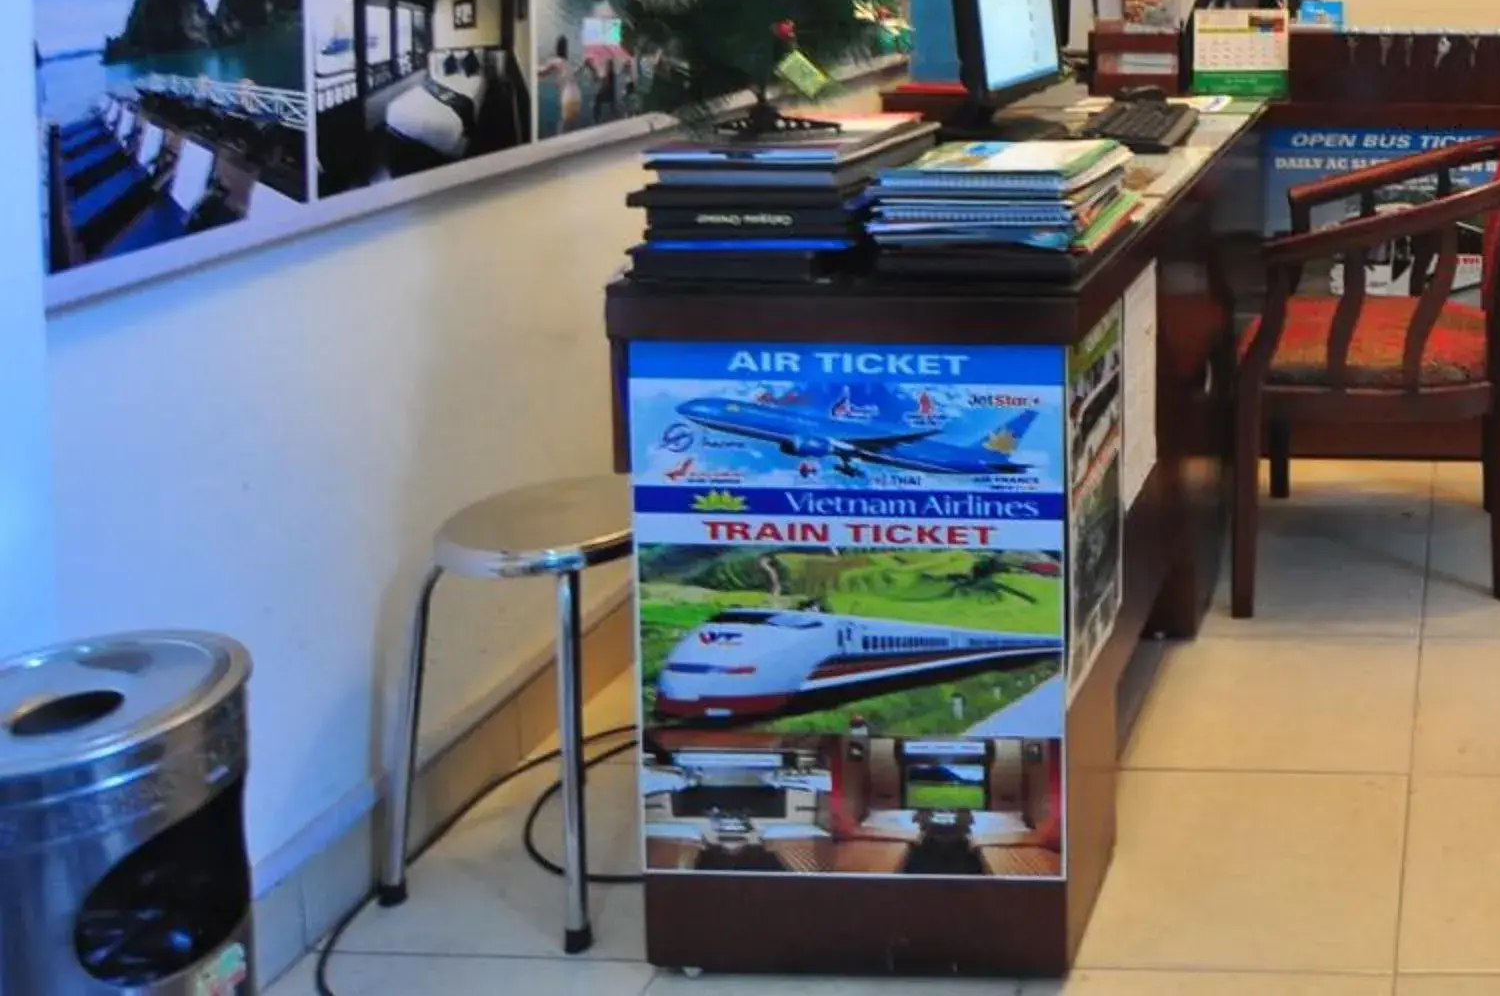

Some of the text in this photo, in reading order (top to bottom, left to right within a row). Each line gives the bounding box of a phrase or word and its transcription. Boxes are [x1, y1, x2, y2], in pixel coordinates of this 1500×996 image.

[1290, 132, 1357, 148] OPEN
[1362, 133, 1412, 149] BUS
[1274, 156, 1322, 170] DAILY
[727, 350, 970, 376] AIR TICKET
[784, 490, 1041, 519] Vietnam Airlines
[701, 520, 999, 546] TRAIN TICKET
